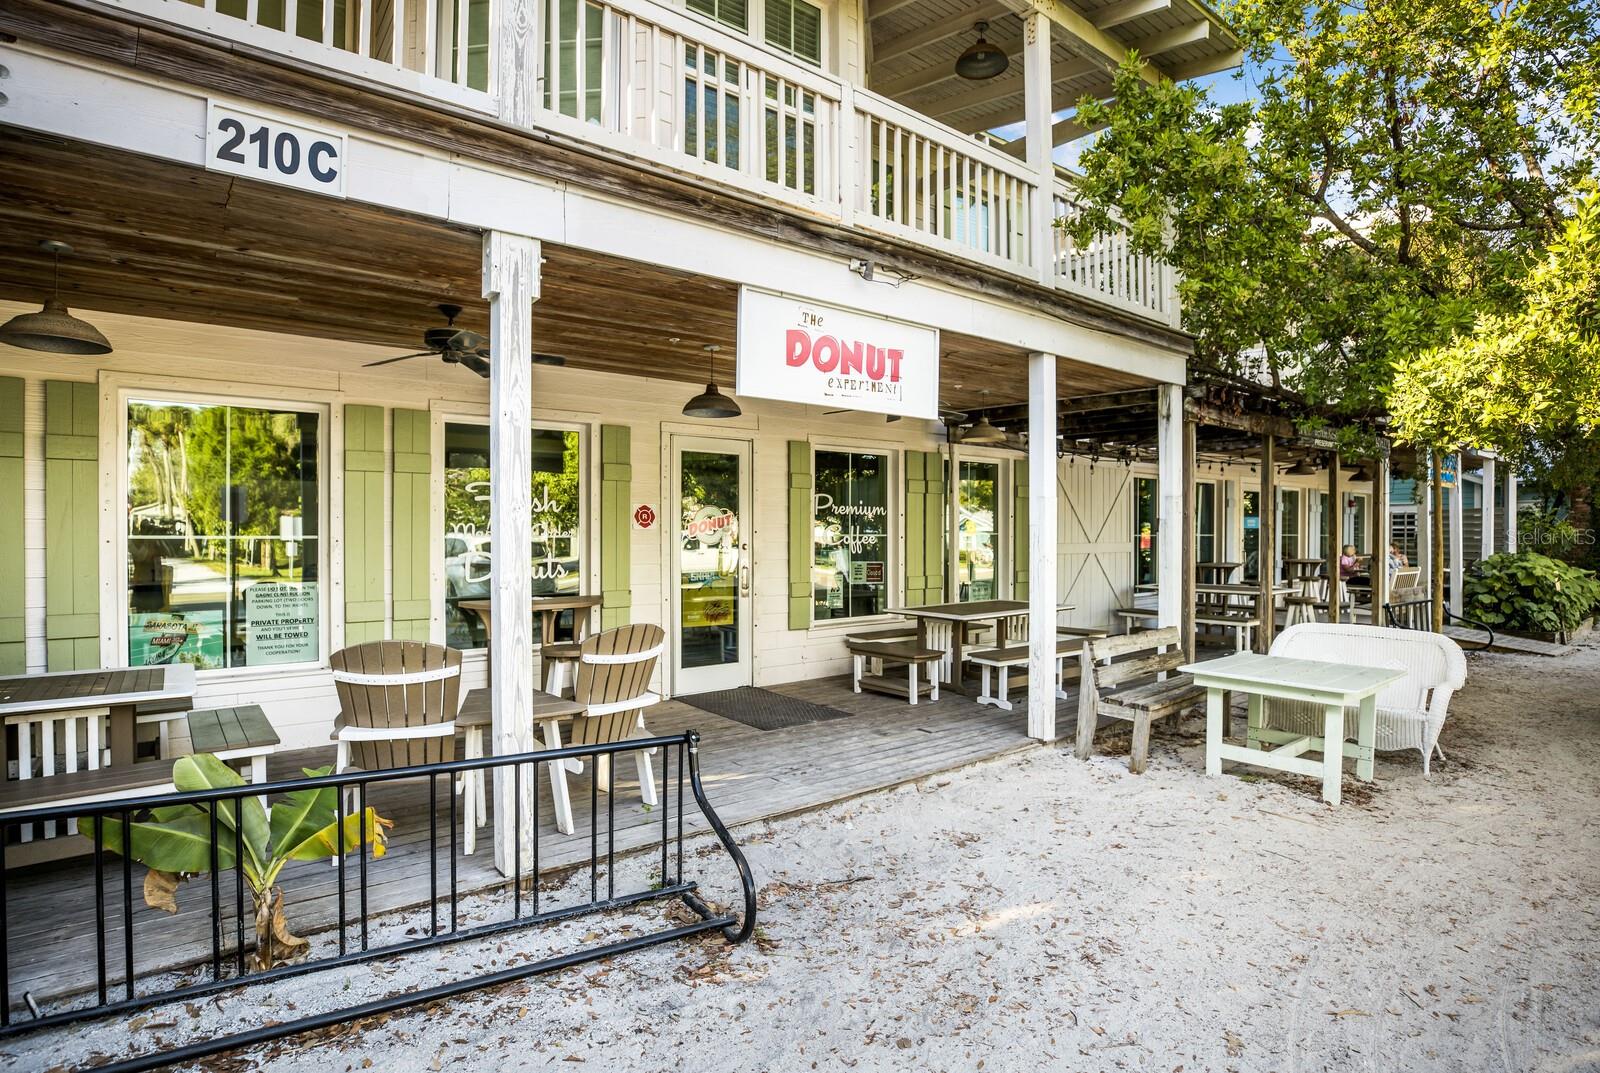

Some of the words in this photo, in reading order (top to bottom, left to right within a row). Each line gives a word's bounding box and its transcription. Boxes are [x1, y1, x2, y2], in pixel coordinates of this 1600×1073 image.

[786, 329, 904, 382] DONUT
[814, 493, 887, 516] Premium
[688, 512, 734, 537] DONUT
[825, 523, 878, 554] Coffee
[251, 619, 279, 627] PRIVATE
[284, 631, 309, 639] TOWED
